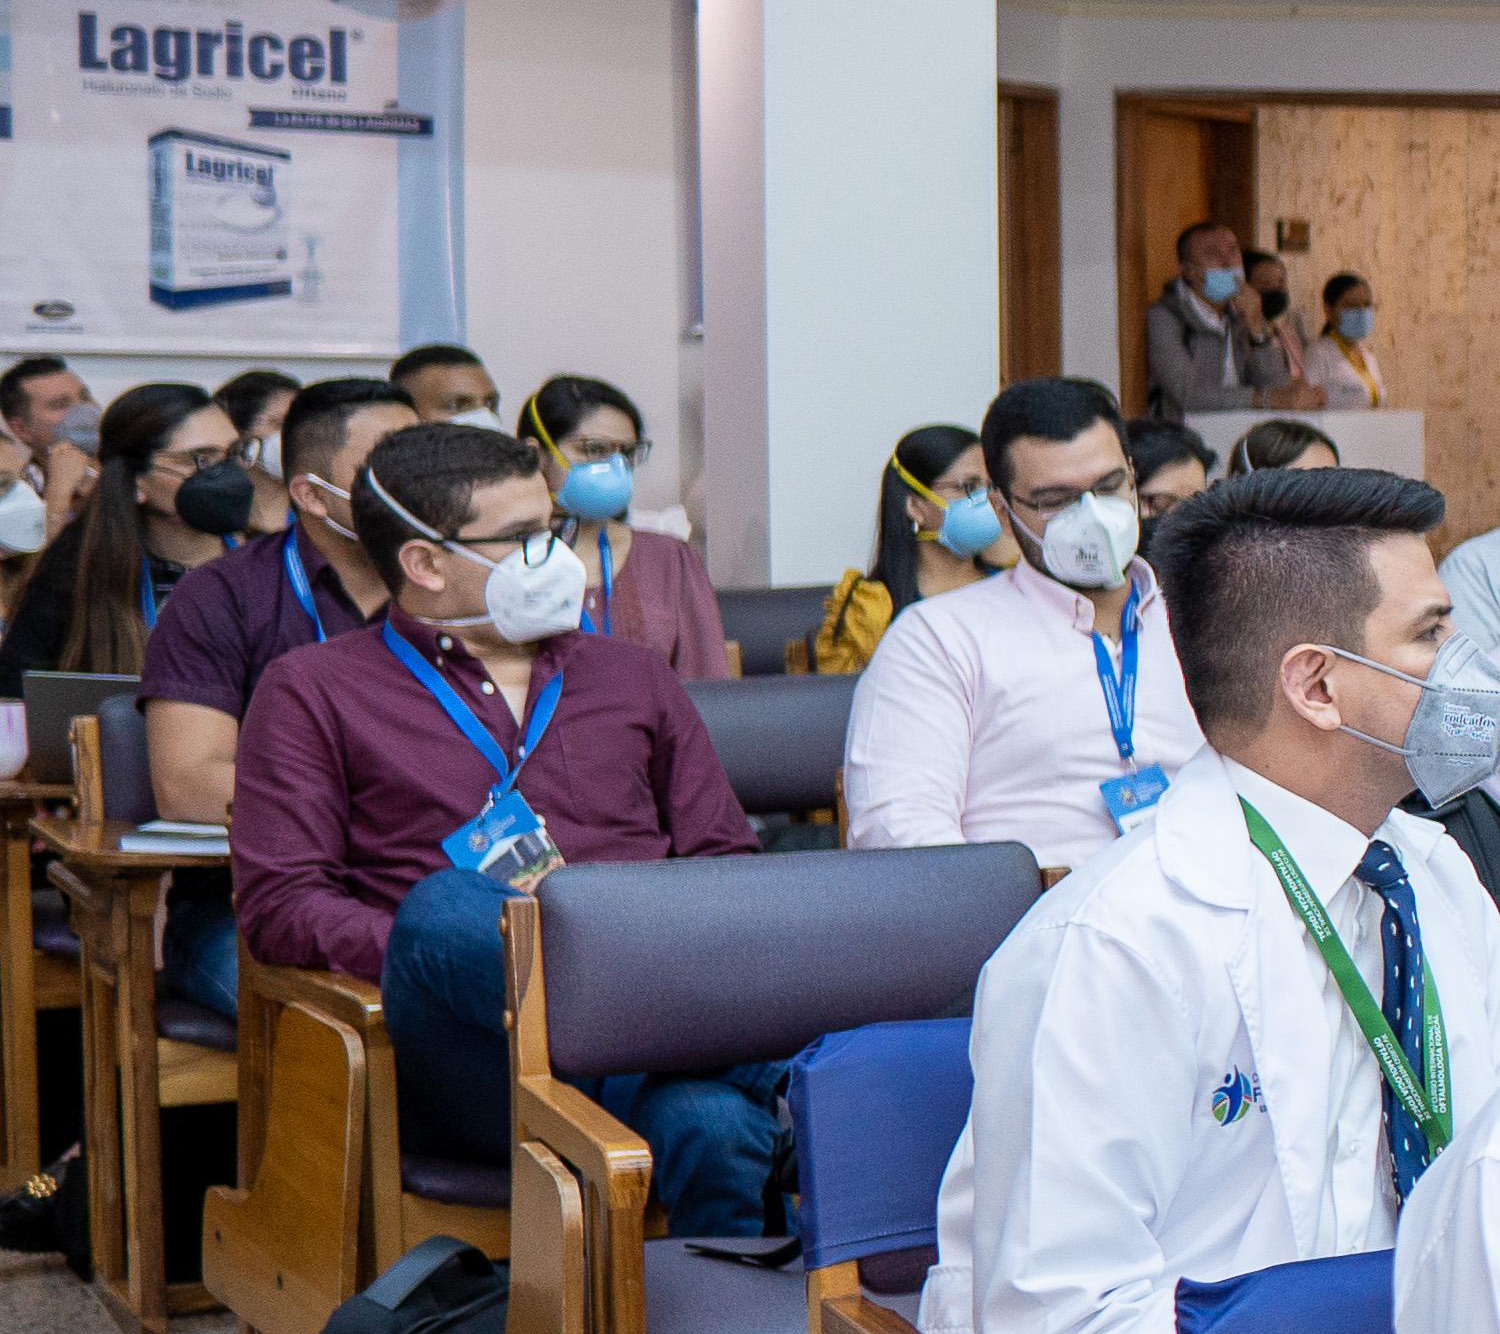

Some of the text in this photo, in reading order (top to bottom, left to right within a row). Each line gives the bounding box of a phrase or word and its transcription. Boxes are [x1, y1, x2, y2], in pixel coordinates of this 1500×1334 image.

[78, 11, 348, 85] Lagricel
[185, 151, 274, 186] Lagricel
[1305, 910, 1326, 943] FOSCAL
[1405, 1095, 1425, 1122] FOSCAL
